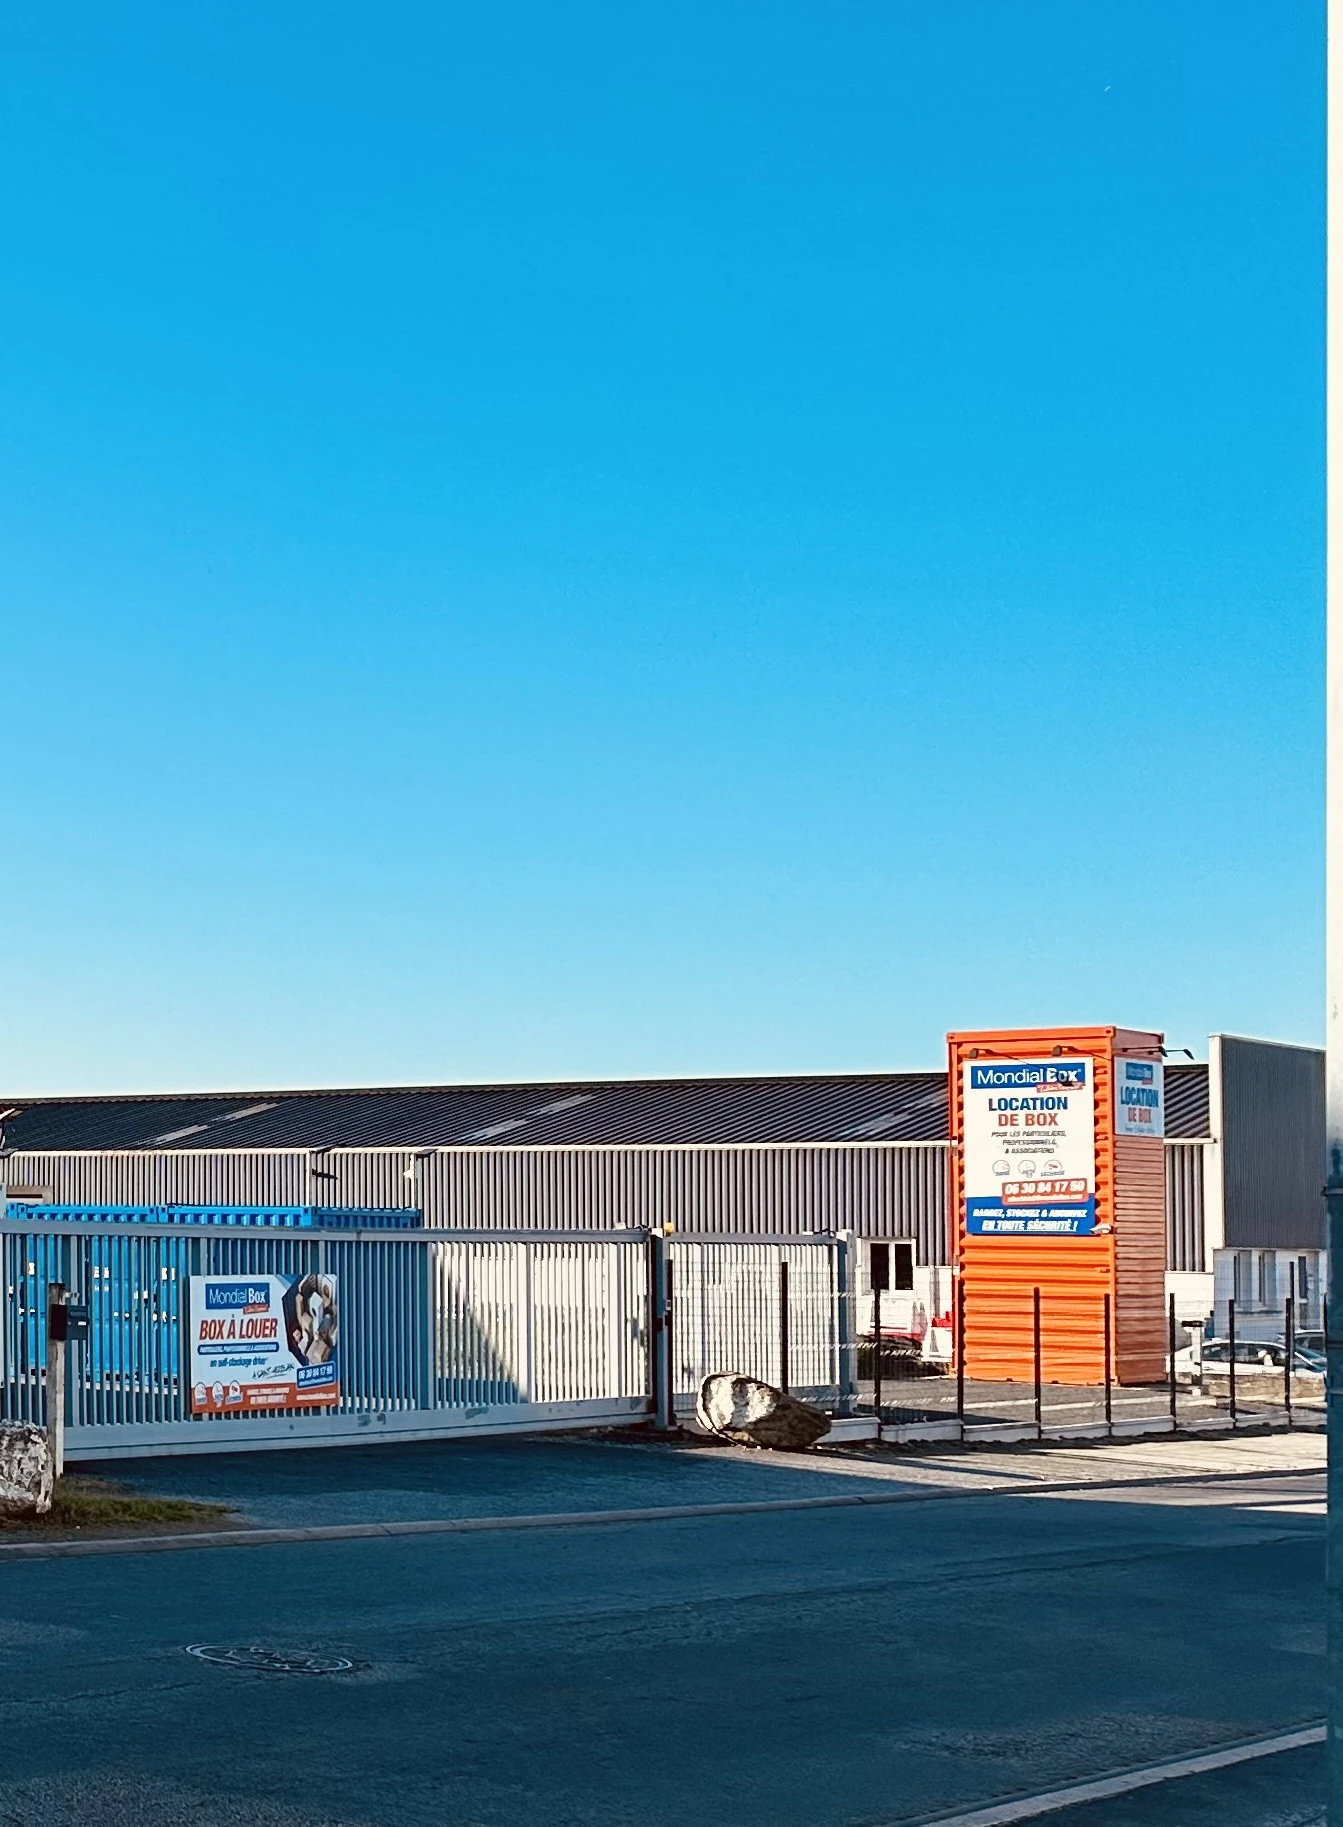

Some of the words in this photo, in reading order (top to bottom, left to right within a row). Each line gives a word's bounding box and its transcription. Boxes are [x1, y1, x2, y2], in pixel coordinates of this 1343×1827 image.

[988, 1097, 1068, 1112] LOCATION
[1120, 1086, 1159, 1108] LOCATION
[998, 1113, 1019, 1127] DE
[1025, 1112, 1059, 1127] BOX
[1128, 1107, 1137, 1122] DE
[1020, 1183, 1035, 1194] 30
[1054, 1181, 1068, 1192] 17
[199, 1319, 226, 1340] BOX
[227, 1313, 236, 1340] À
[239, 1318, 278, 1339] LOUER
